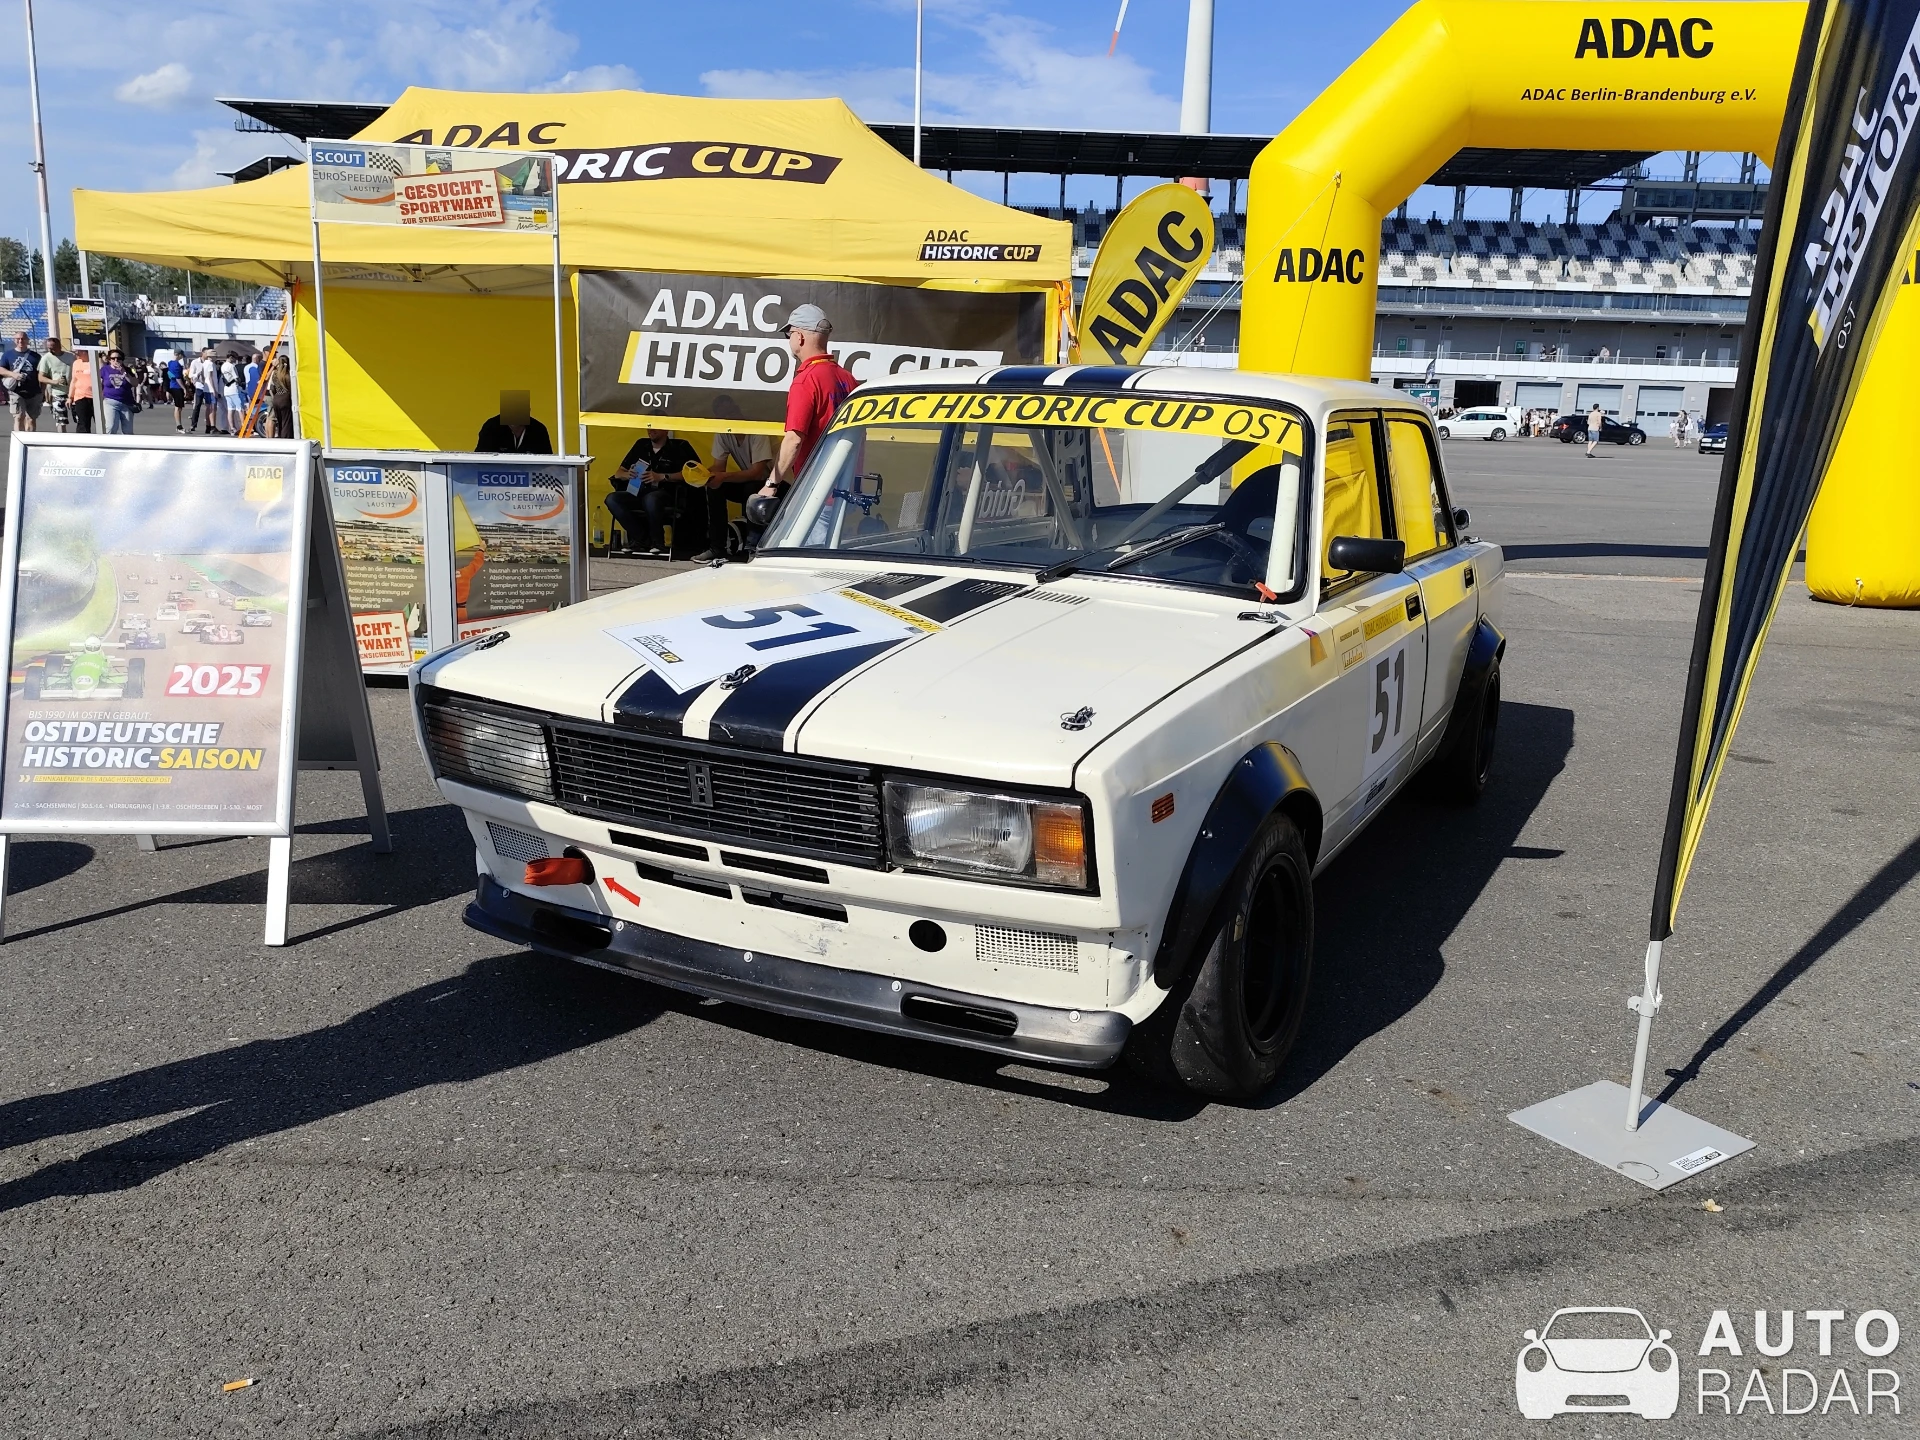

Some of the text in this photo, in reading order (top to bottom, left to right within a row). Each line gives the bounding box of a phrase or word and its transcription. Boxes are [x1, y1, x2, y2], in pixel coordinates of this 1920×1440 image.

[1574, 17, 1714, 60] ADAC
[1520, 87, 1758, 105] ADAC Berlin-Brandenburg e.V.
[391, 121, 567, 149] ADAC
[315, 151, 362, 165] SCOUT
[691, 145, 814, 177] CUP
[349, 185, 381, 193] LAUSITZ
[399, 195, 494, 216] SPORTWART
[401, 210, 497, 225] ZUR STRECKENSICHERUNG
[923, 229, 970, 243] ADAC
[924, 245, 1035, 260] HISTORIC CUP
[1273, 247, 1365, 285] ADAC
[1088, 210, 1204, 365] ADAC
[642, 288, 782, 333] ADAC
[1837, 300, 1856, 349] OST
[640, 390, 673, 408] OST
[829, 395, 927, 429] ADAC
[927, 394, 1118, 424] HISTORIC
[1123, 400, 1215, 431] CUP
[1223, 408, 1302, 445] OST
[43, 467, 102, 477] HISTORIC CUP
[247, 466, 283, 480] ADAC
[336, 470, 379, 482] SCOUT
[481, 473, 527, 486] SCOUT
[346, 571, 378, 580] Absicherung
[375, 589, 401, 597] Spannung
[519, 589, 545, 597] Spannung
[701, 603, 862, 652] 51
[168, 663, 264, 697] 2025
[1371, 647, 1405, 755] 51
[28, 710, 152, 721] BIS 1990 IM OSTEN GEBAUT:
[24, 721, 220, 744] OSTDEUTSCHE
[22, 746, 264, 770] HISTORIC-SAISON
